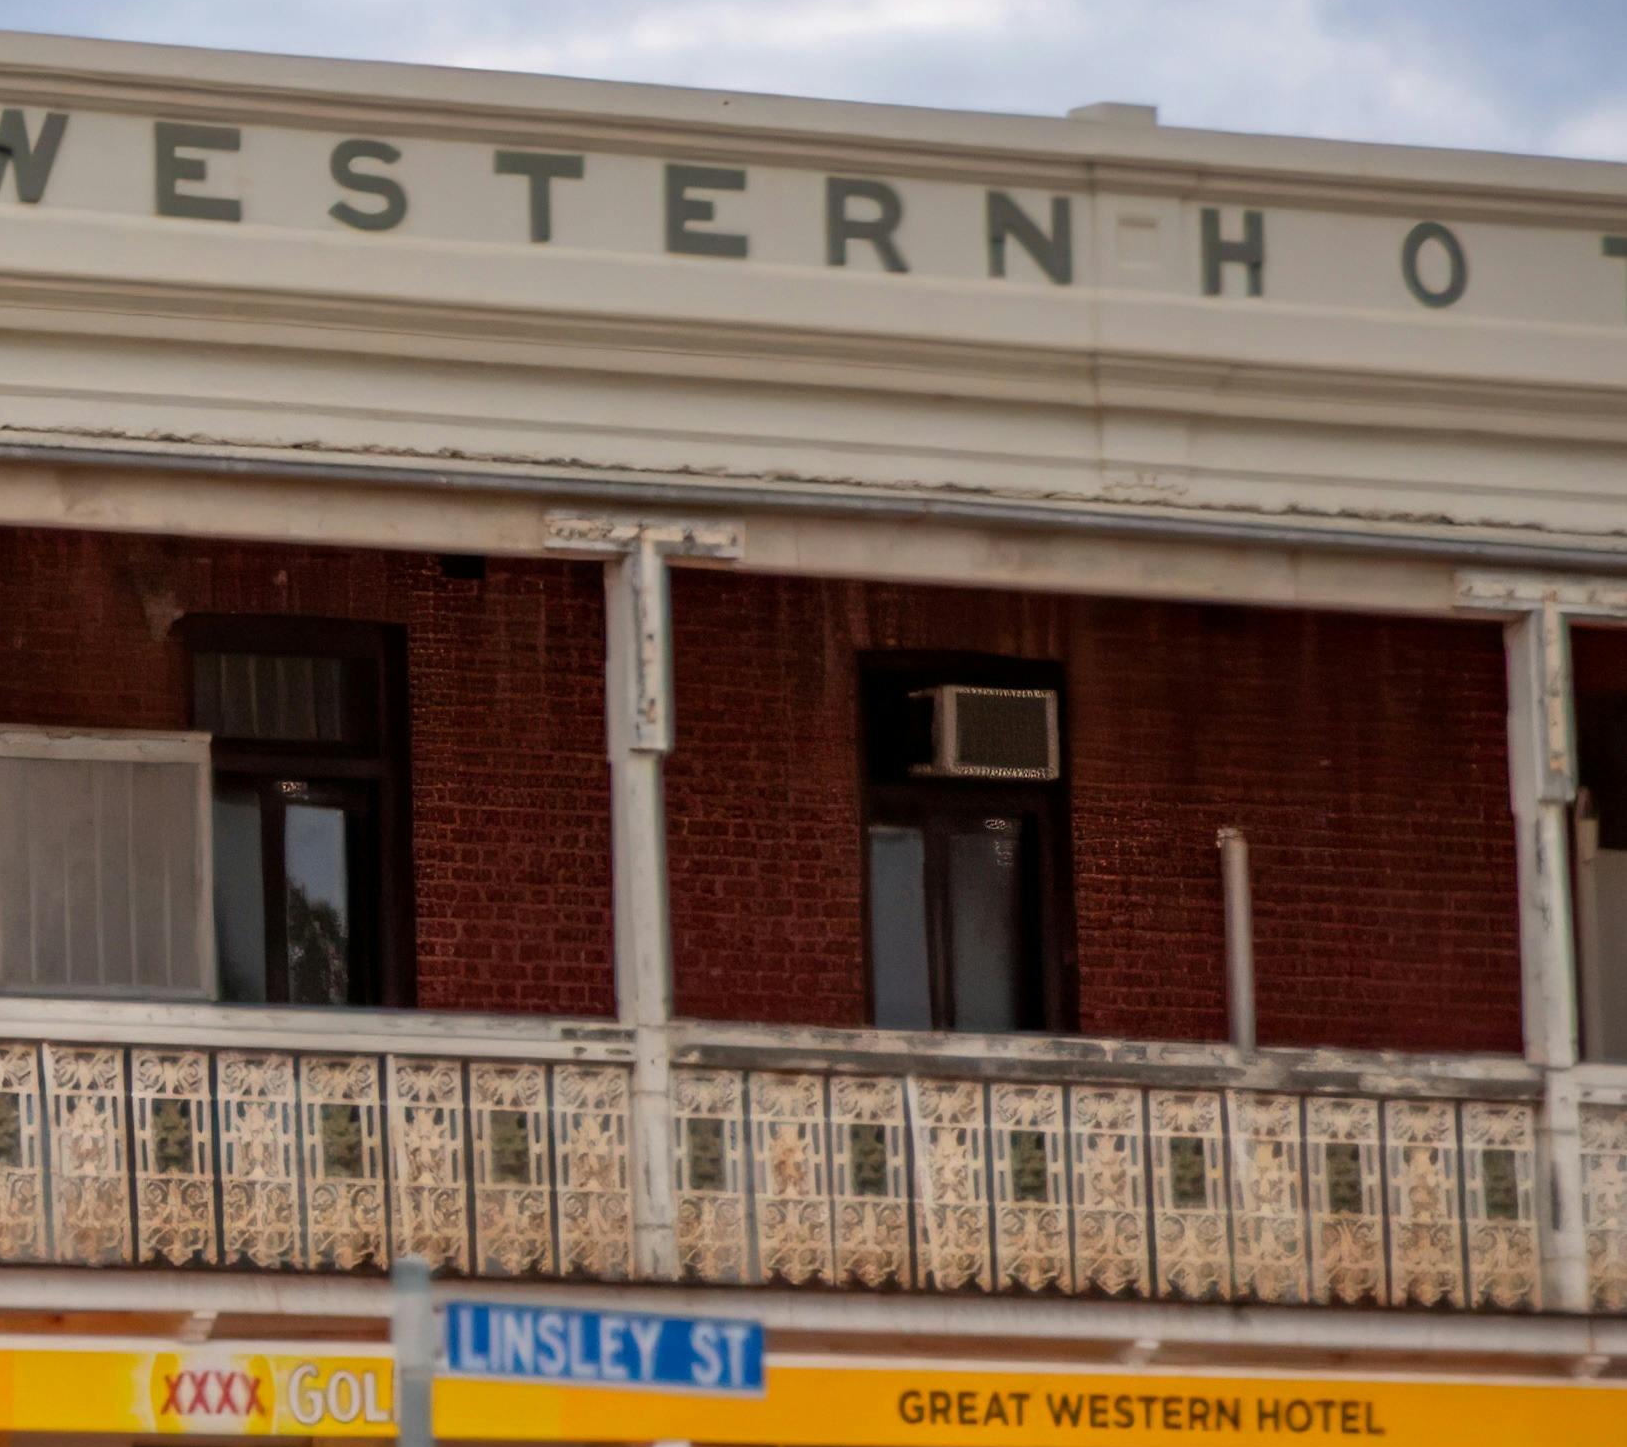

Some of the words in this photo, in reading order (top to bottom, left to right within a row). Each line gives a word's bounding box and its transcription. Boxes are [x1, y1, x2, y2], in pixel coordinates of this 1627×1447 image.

[1200, 206, 1627, 309] HO
[457, 1307, 664, 1381] LINSLEY
[689, 1322, 753, 1388] ST
[160, 1369, 268, 1418] XXXX
[287, 1362, 398, 1427] GOL
[898, 1389, 1031, 1427] GREAT
[1046, 1392, 1242, 1433] WESTERN
[1257, 1397, 1387, 1436] HOTEL
